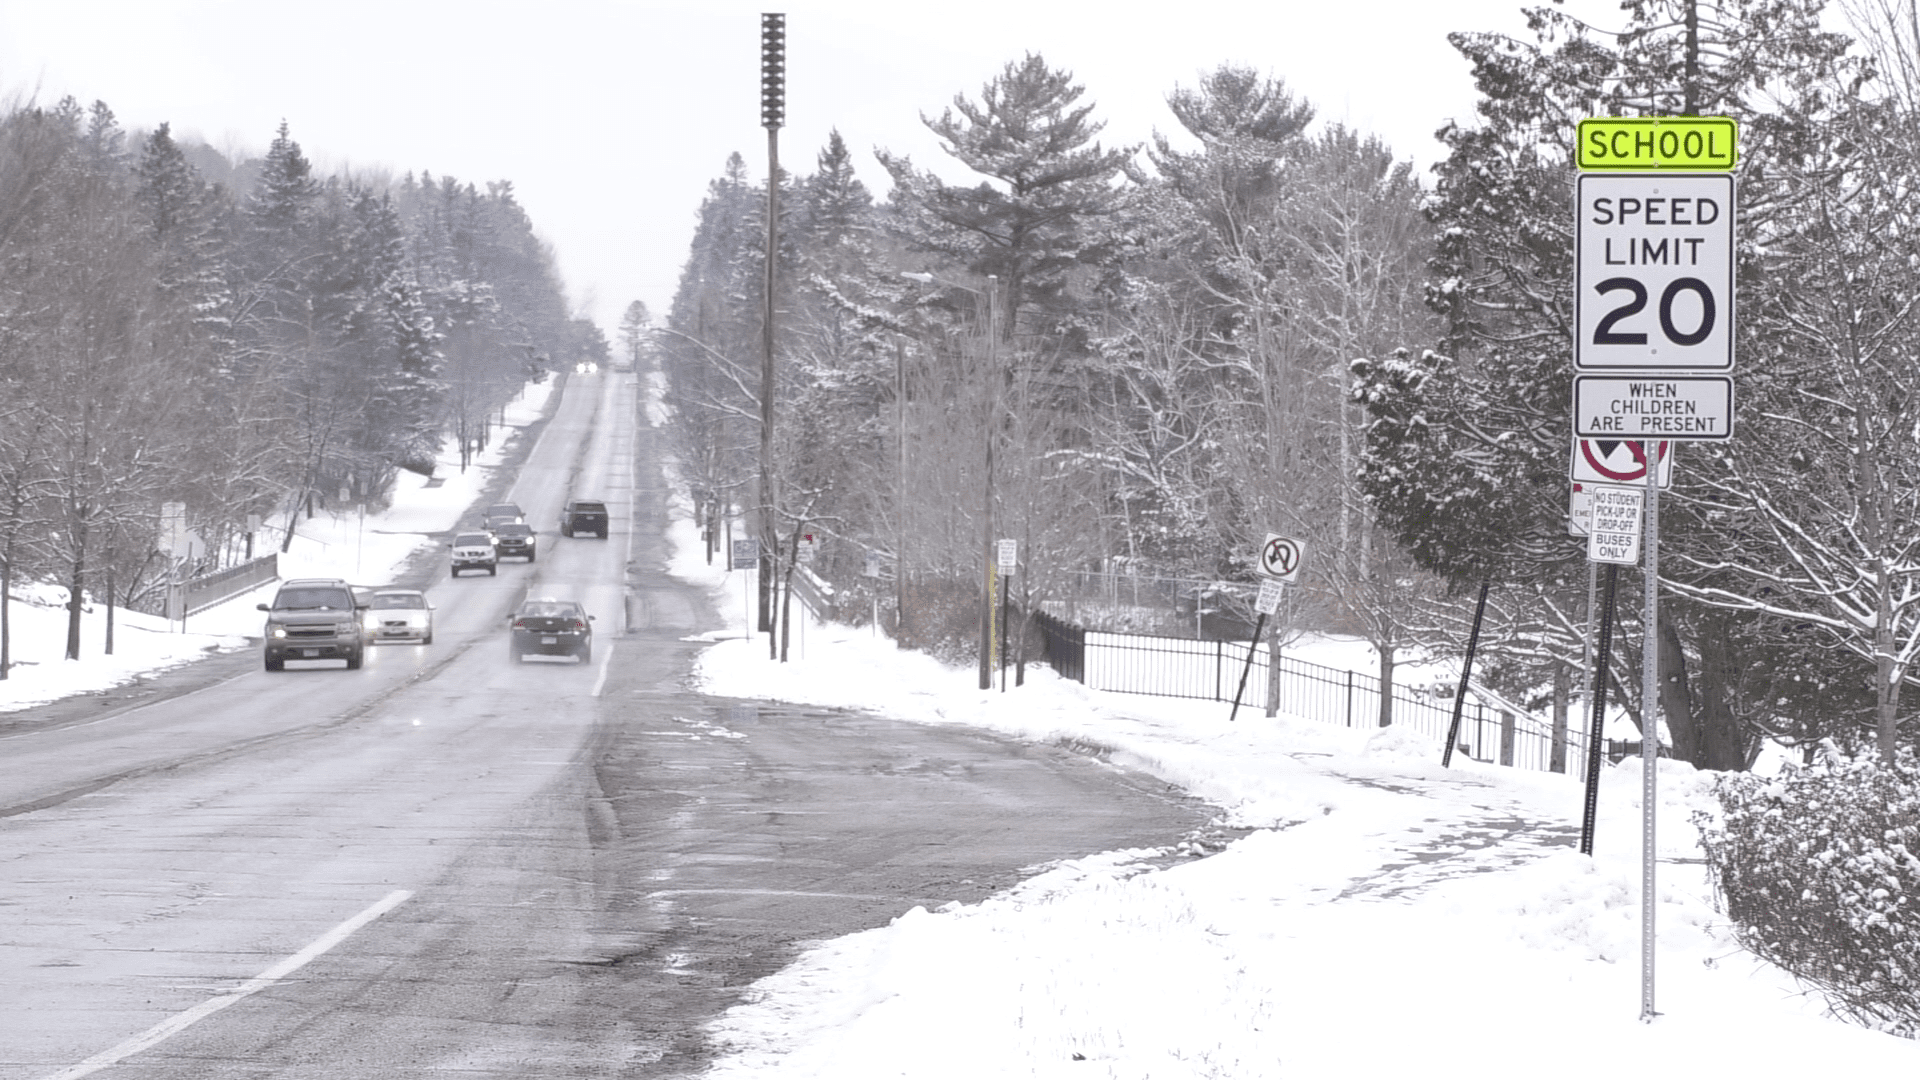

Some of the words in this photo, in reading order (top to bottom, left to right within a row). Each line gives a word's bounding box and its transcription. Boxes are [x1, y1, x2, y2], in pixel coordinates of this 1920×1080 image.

[1589, 130, 1726, 159] SCHOOL
[1592, 197, 1719, 225] SPEED
[1605, 237, 1705, 266] LIMIT
[1592, 276, 1716, 346] 20
[1629, 383, 1677, 398] WHEN
[1610, 399, 1696, 415] CHILDREN
[1590, 416, 1624, 431] ARE
[1640, 416, 1716, 432] PRESENT
[1595, 492, 1606, 504] NO
[1607, 493, 1641, 506] STUDENT
[1596, 505, 1625, 518] PICK-UP
[1626, 507, 1637, 519] OR
[1597, 518, 1634, 531] DROP-OFF
[1596, 534, 1632, 547] BUSES
[1599, 546, 1628, 559] ONLY
